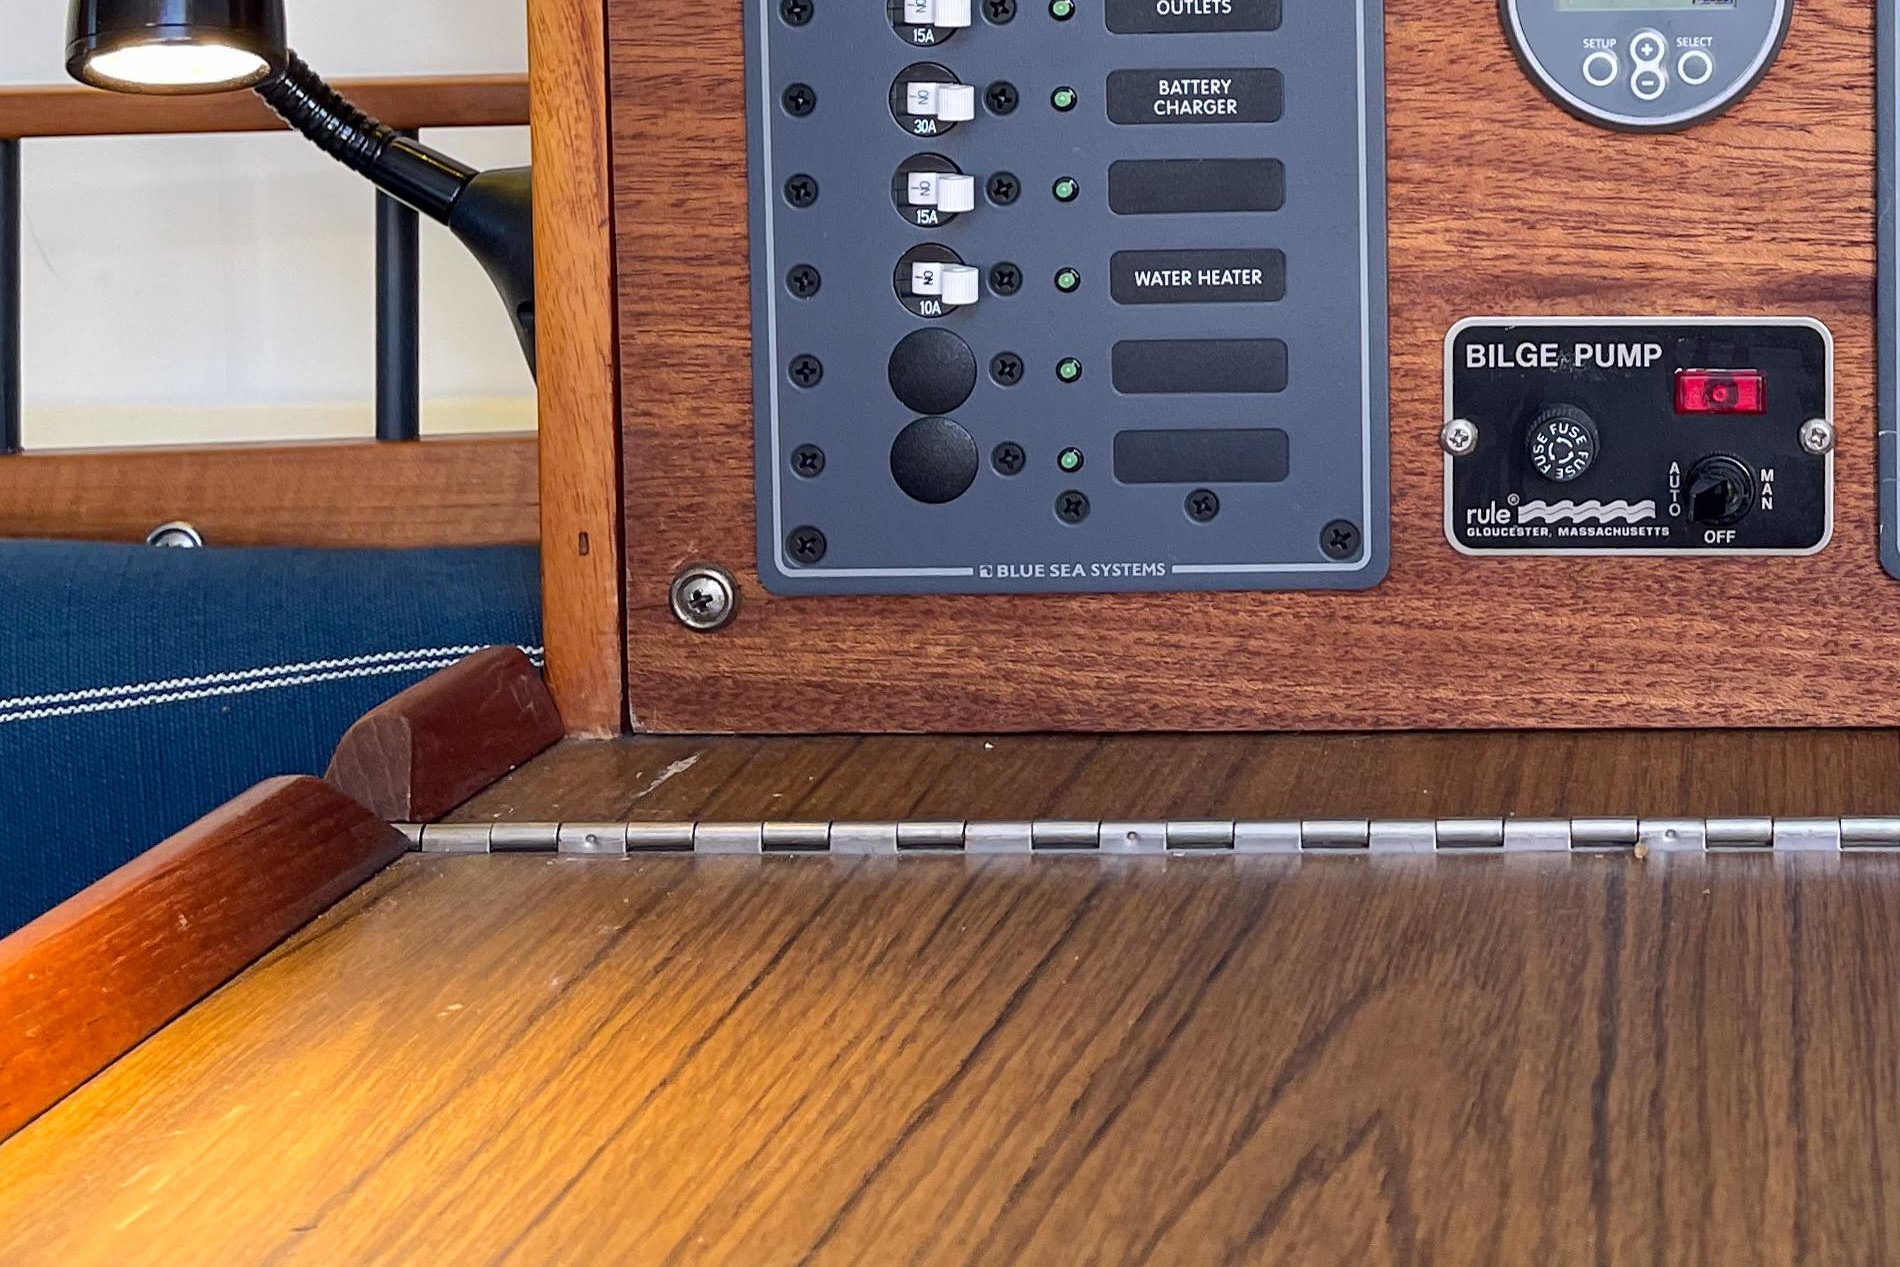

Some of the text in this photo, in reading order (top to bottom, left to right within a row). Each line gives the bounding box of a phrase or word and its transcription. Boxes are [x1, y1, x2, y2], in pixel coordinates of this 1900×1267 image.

[913, 28, 935, 43] 15A
[1583, 38, 1617, 48] SETUP
[1676, 36, 1713, 47] SELECT
[1159, 79, 1232, 95] BATTERY
[918, 90, 928, 105] ON
[1153, 99, 1238, 115] CHARGER
[914, 119, 937, 134] 30A
[920, 180, 931, 196] ON
[917, 209, 939, 224] 15A
[923, 270, 933, 286] ON
[1134, 269, 1262, 287] WATER HEATER
[920, 300, 941, 315] 10A
[1466, 342, 1663, 368] BILGE PUMP
[1549, 422, 1587, 446] FUSE
[1533, 432, 1551, 474] FUSE
[1555, 451, 1589, 479] FUSE
[1669, 461, 1681, 517] AUTO
[1760, 468, 1774, 510] MAN
[1467, 526, 1670, 538] GLOUCESTER, MASSACHUSETTS
[1704, 530, 1736, 544] OFF
[997, 563, 1166, 578] BLUE SEA SYSTEMS
